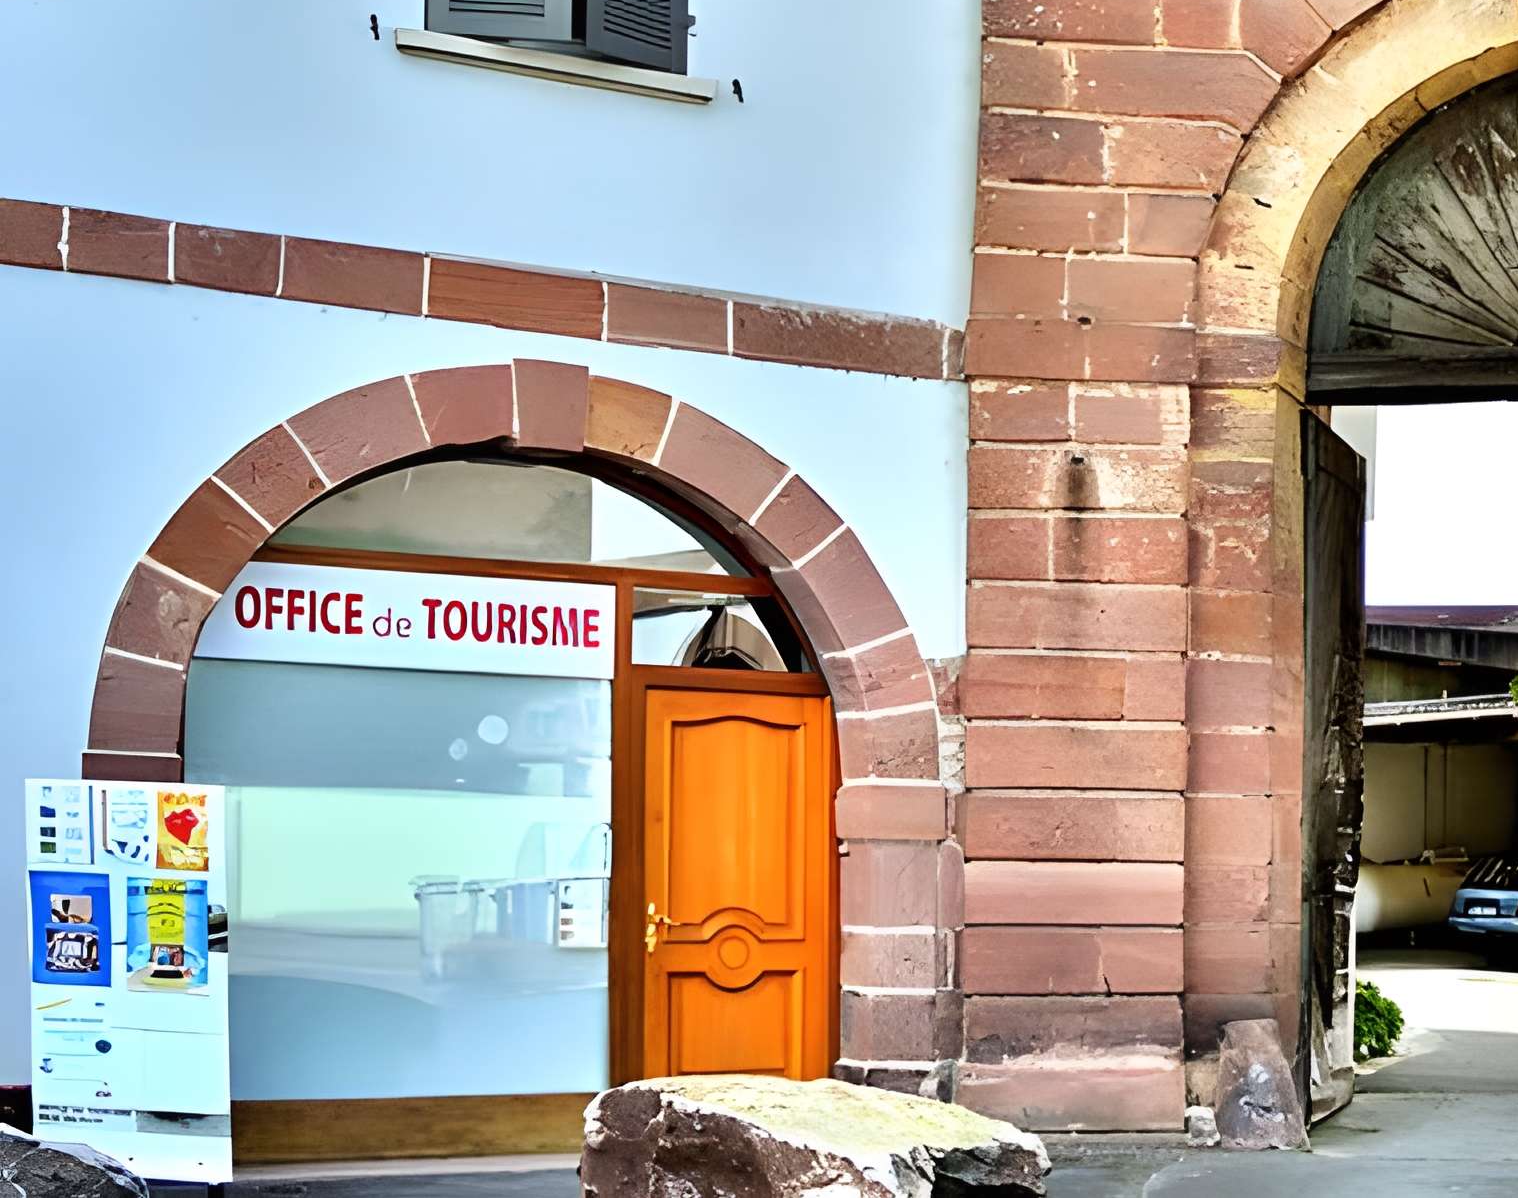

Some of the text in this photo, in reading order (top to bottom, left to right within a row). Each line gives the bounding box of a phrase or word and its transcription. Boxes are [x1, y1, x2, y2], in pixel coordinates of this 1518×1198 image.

[234, 585, 601, 648] OFFICE de TOURISME
